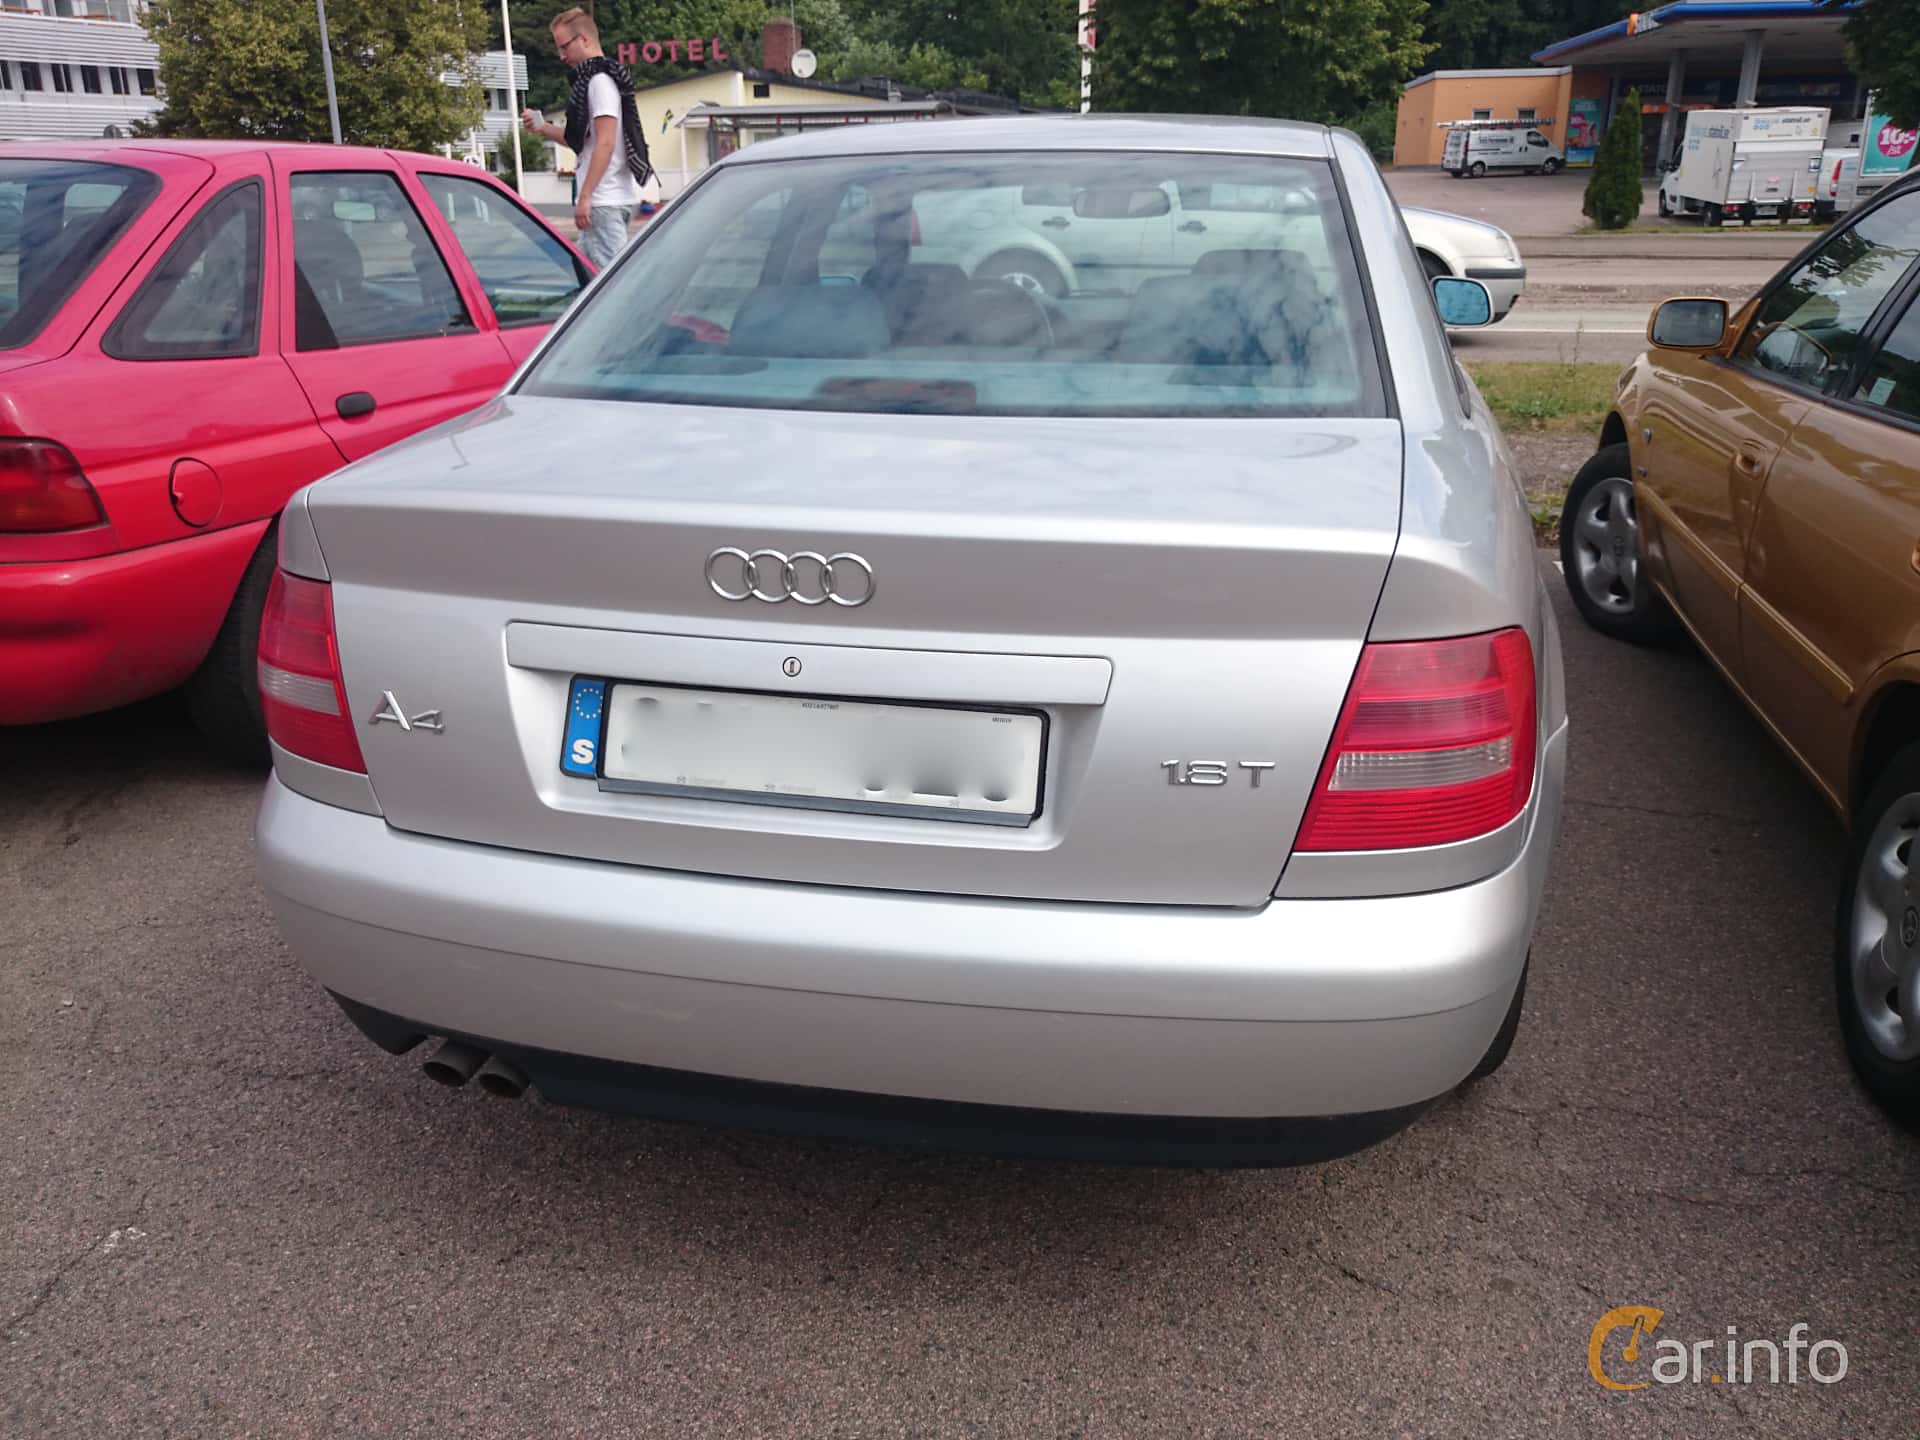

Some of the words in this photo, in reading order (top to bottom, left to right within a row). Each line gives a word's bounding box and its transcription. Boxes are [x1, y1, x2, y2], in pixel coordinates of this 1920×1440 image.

[617, 37, 729, 65] HOTEL
[368, 690, 446, 735] A4
[571, 739, 595, 765] S
[1160, 759, 1228, 786] 1.8
[1238, 760, 1277, 788] T
